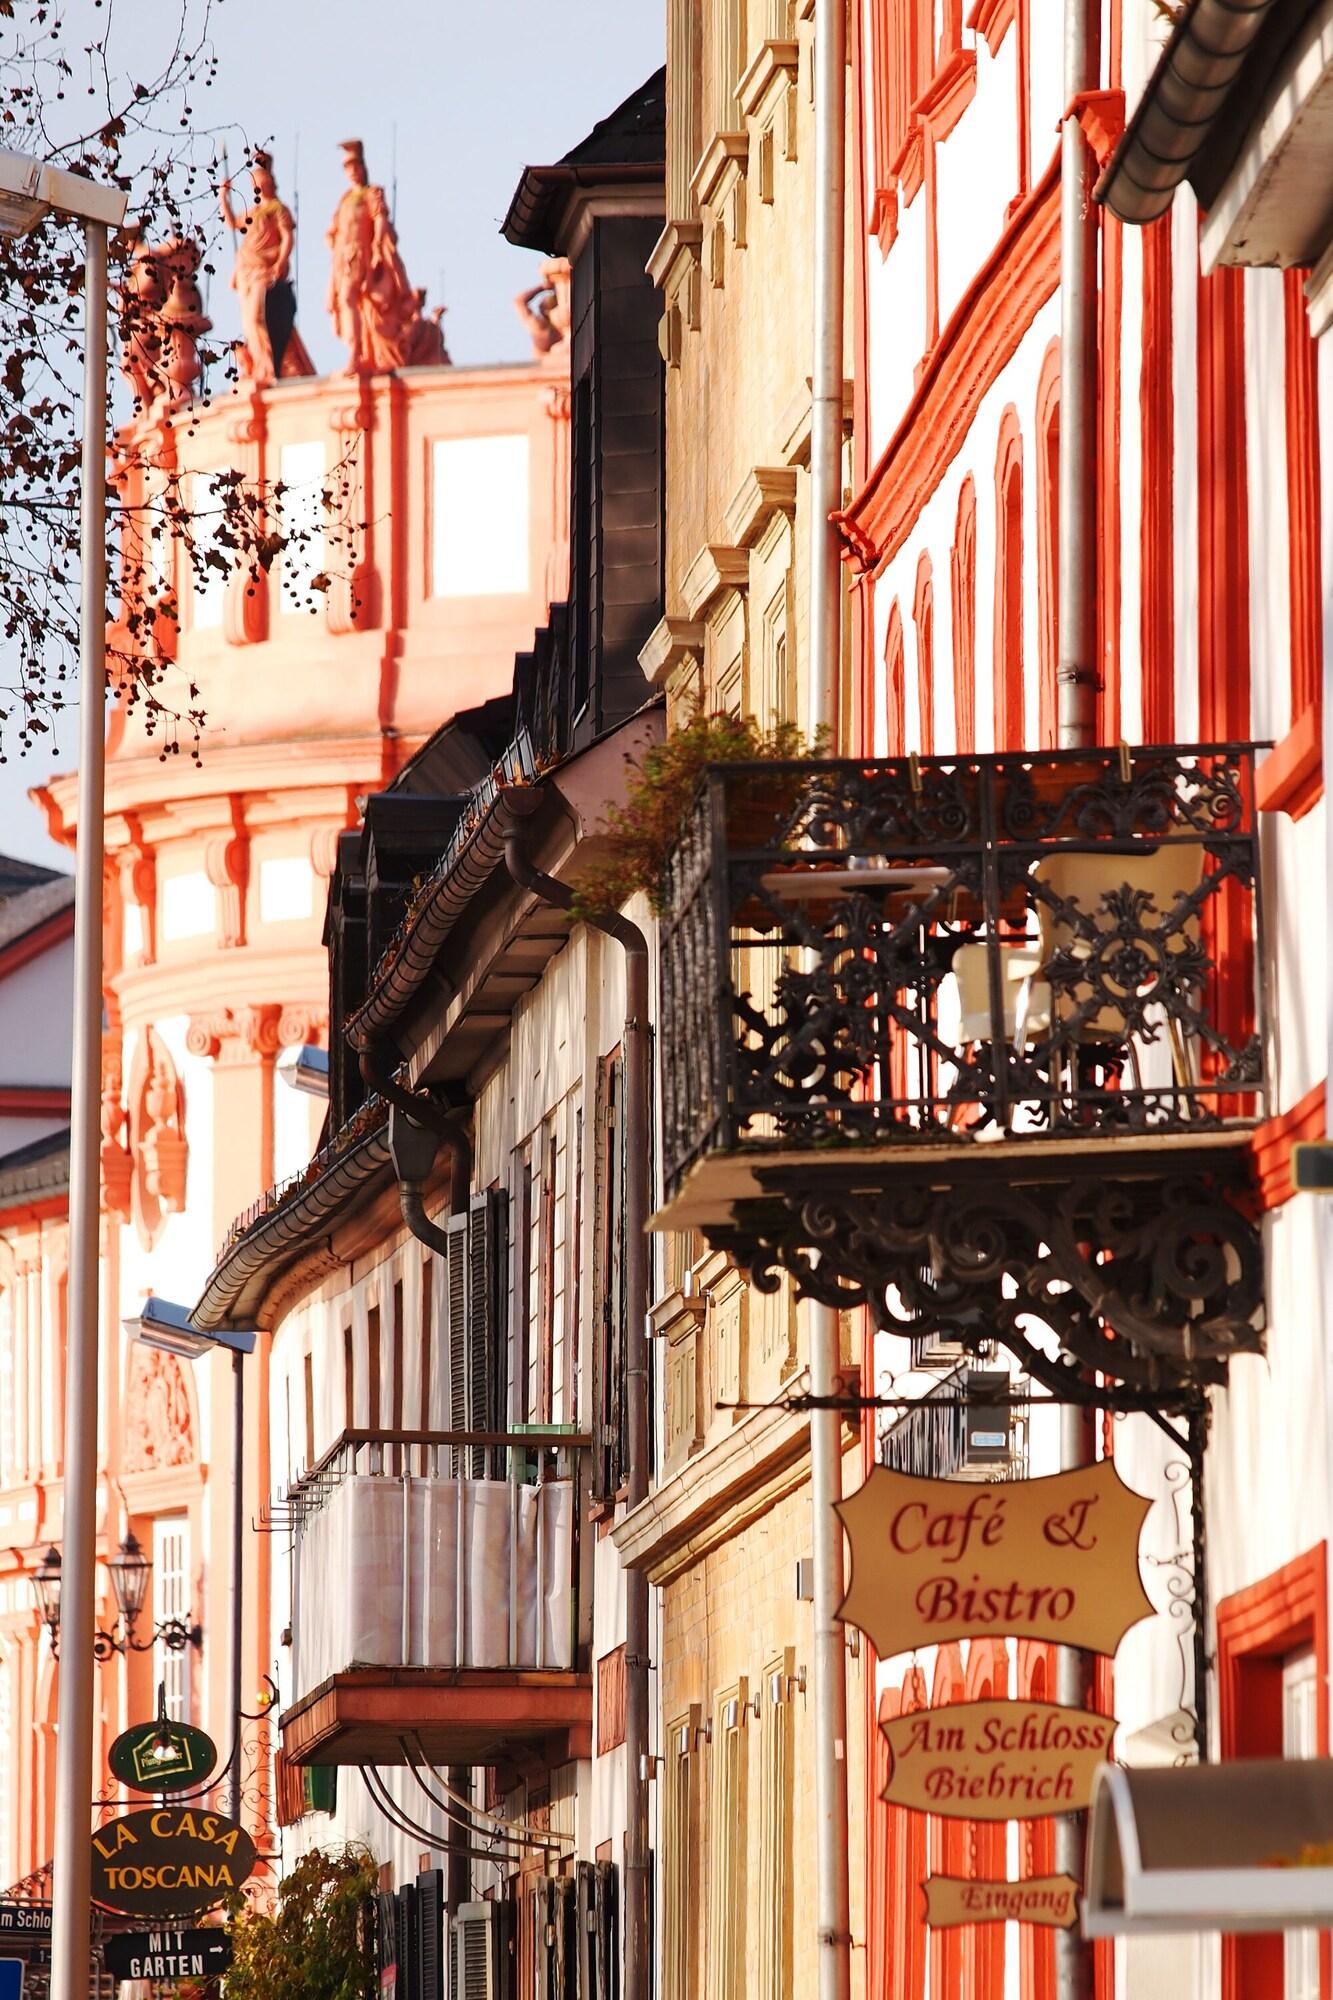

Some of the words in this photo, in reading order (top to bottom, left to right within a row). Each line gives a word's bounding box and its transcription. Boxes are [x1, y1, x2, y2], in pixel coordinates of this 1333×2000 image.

[889, 1493, 1006, 1563] Café
[1042, 1493, 1099, 1550] &
[915, 1573, 1075, 1624] Bistro
[898, 1719, 965, 1758] Am
[975, 1712, 1105, 1755] Schloss
[924, 1761, 1074, 1800] Biebrich
[92, 1823, 138, 1859] LA
[150, 1812, 239, 1855] CASA
[103, 1865, 233, 1889] TOSCANA
[961, 1886, 1070, 1917] Eingang
[1, 1913, 13, 1928] m
[17, 1910, 51, 1929] Schlo
[149, 1931, 184, 1952] MIT
[130, 1955, 203, 1977] GARTEN
